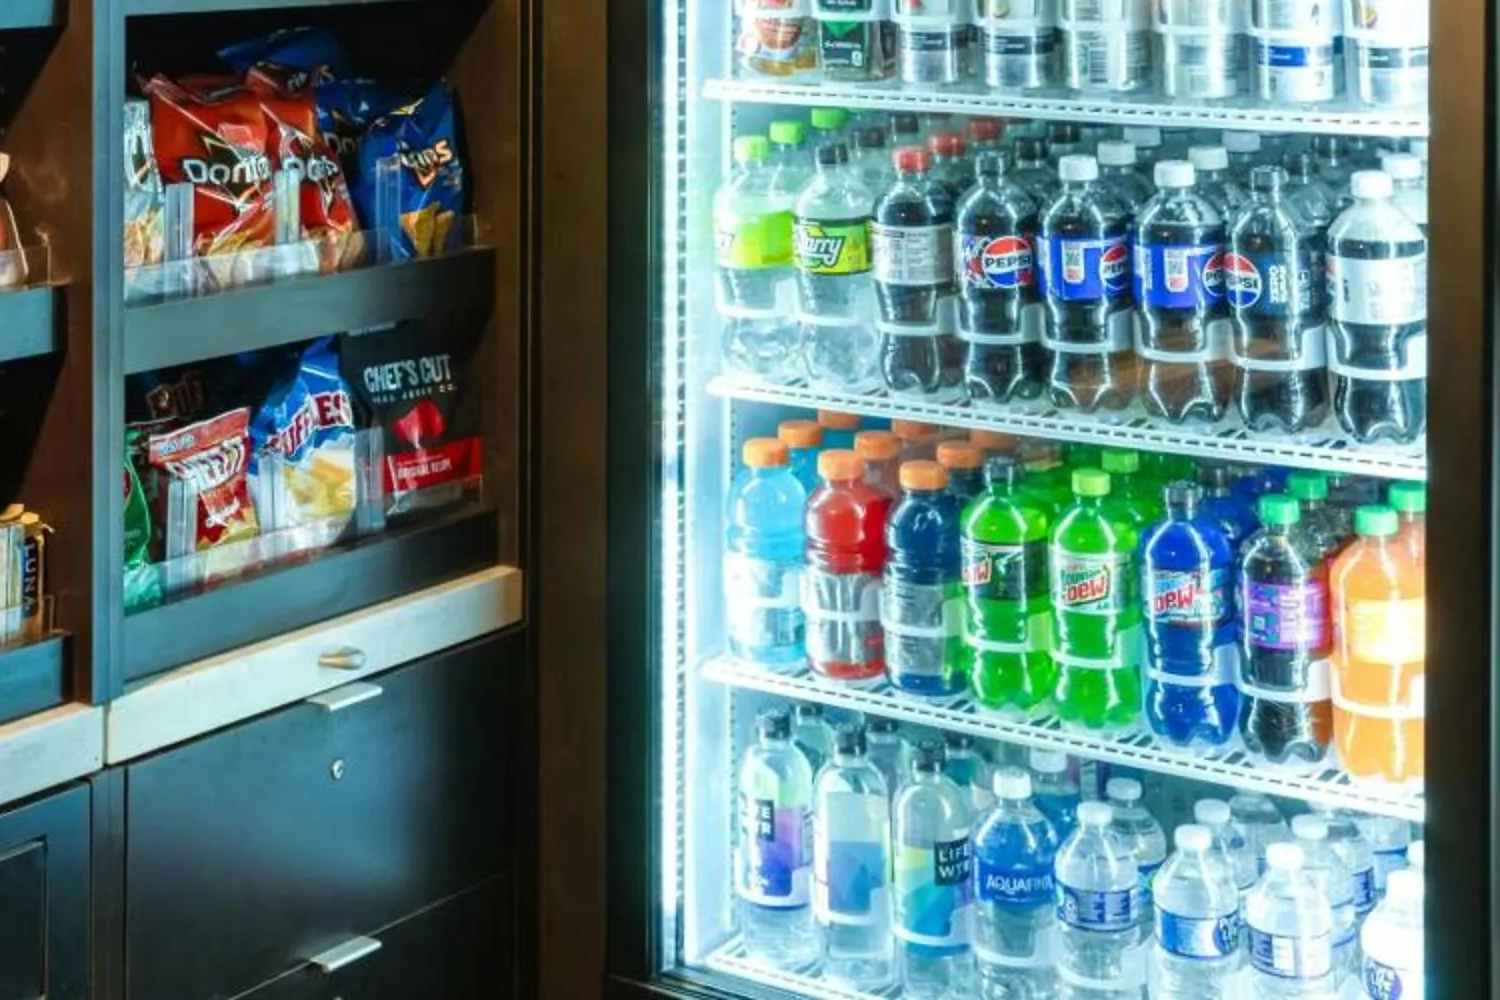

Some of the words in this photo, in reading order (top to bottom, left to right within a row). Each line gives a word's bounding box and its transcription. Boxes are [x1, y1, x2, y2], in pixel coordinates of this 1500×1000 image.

[985, 253, 1032, 268] PEPSI
[363, 359, 420, 393] CHEF'S
[420, 353, 453, 384] CUT
[985, 873, 1055, 895] AQUAFINA
